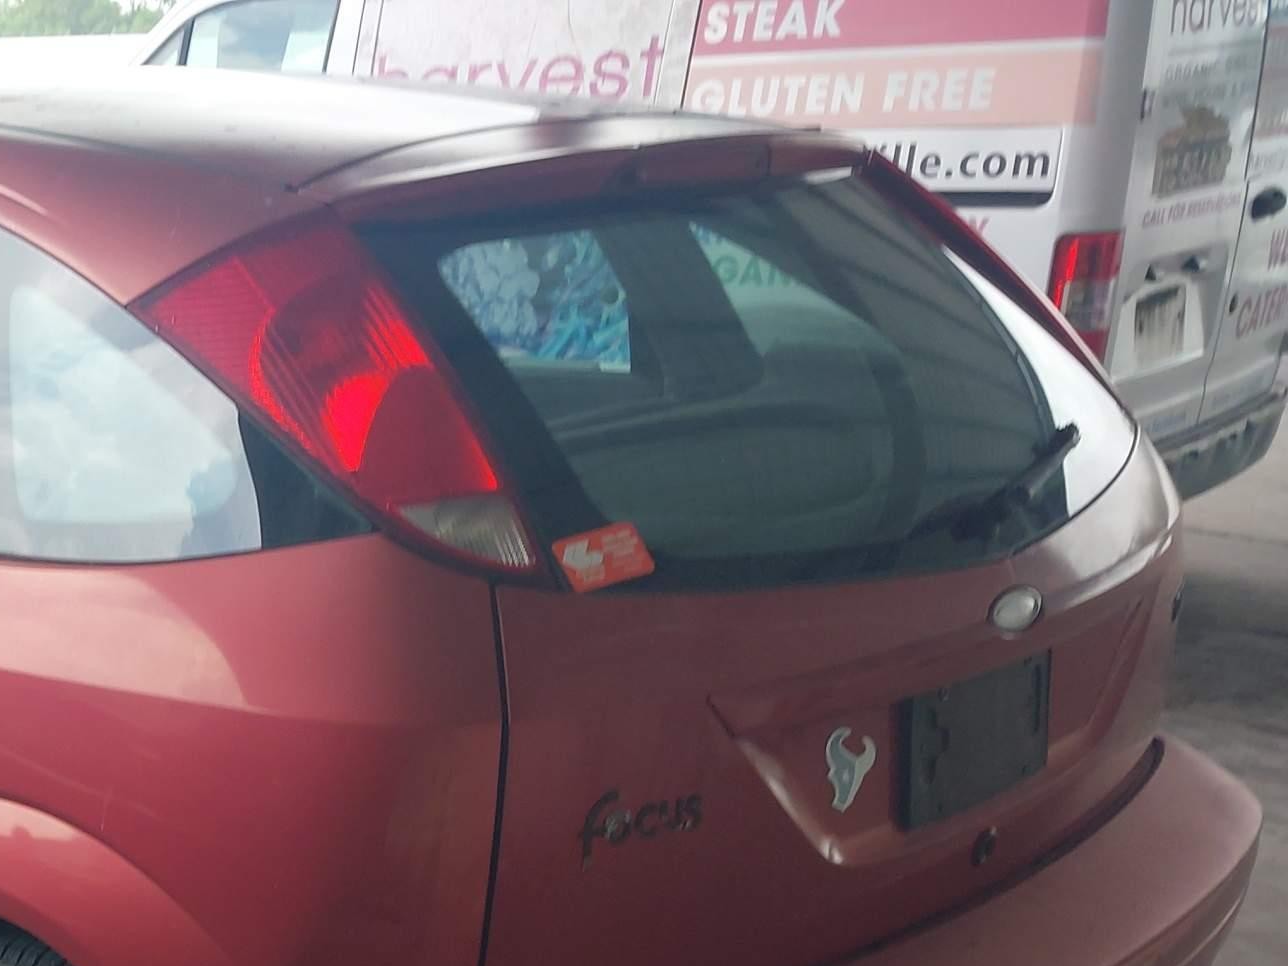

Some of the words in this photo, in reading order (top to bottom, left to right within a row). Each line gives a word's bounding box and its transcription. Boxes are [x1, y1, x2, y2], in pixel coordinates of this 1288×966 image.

[703, 0, 845, 44] STEAK
[690, 74, 864, 117] GLUTEN
[883, 68, 998, 113] FREE
[879, 143, 1051, 178] lle.com
